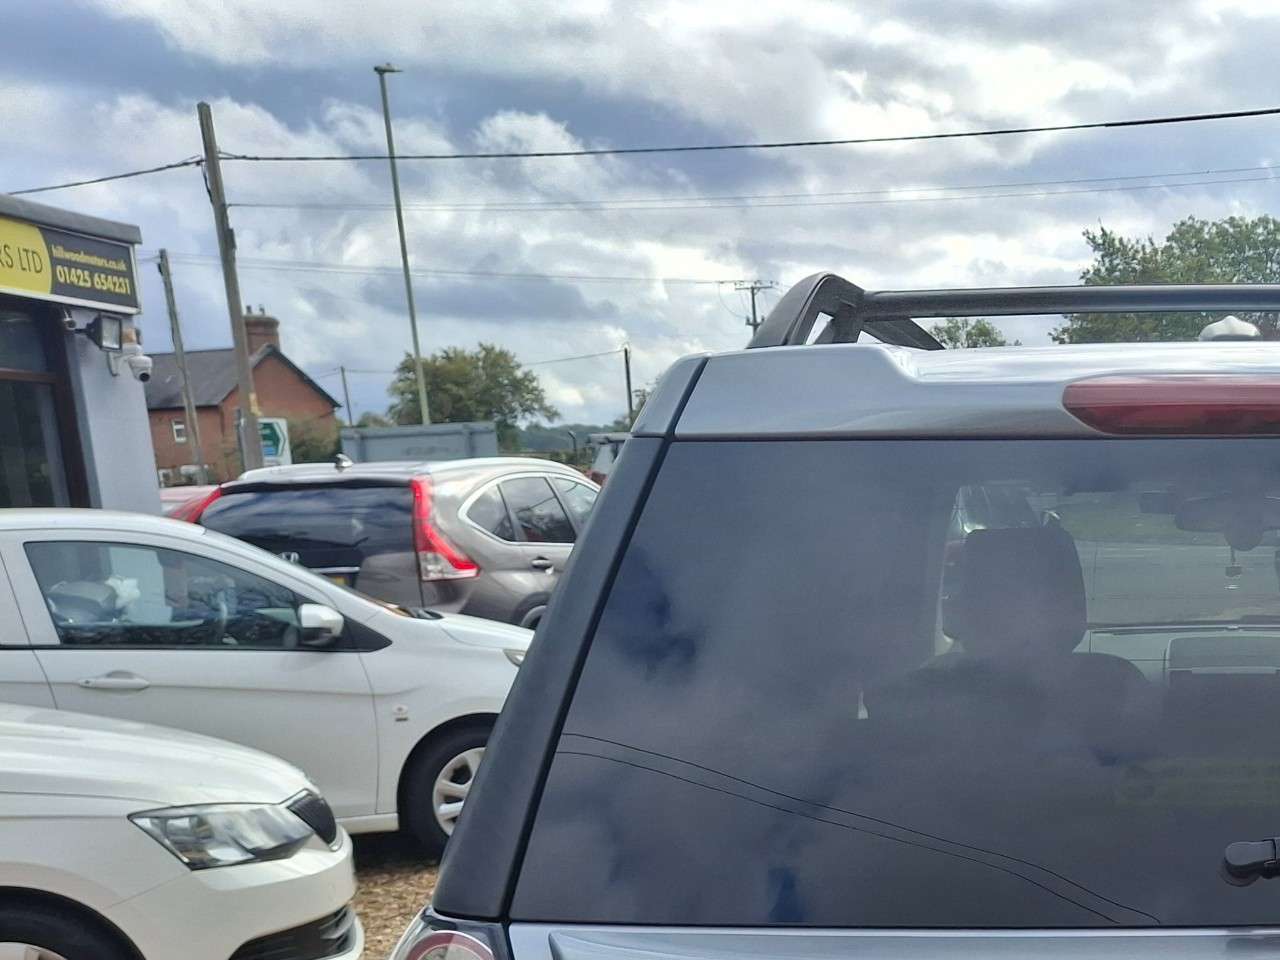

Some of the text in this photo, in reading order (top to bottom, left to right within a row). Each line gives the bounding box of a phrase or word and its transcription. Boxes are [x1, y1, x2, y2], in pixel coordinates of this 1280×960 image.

[17, 247, 43, 274] LTD
[56, 265, 131, 295] 01425 654231
